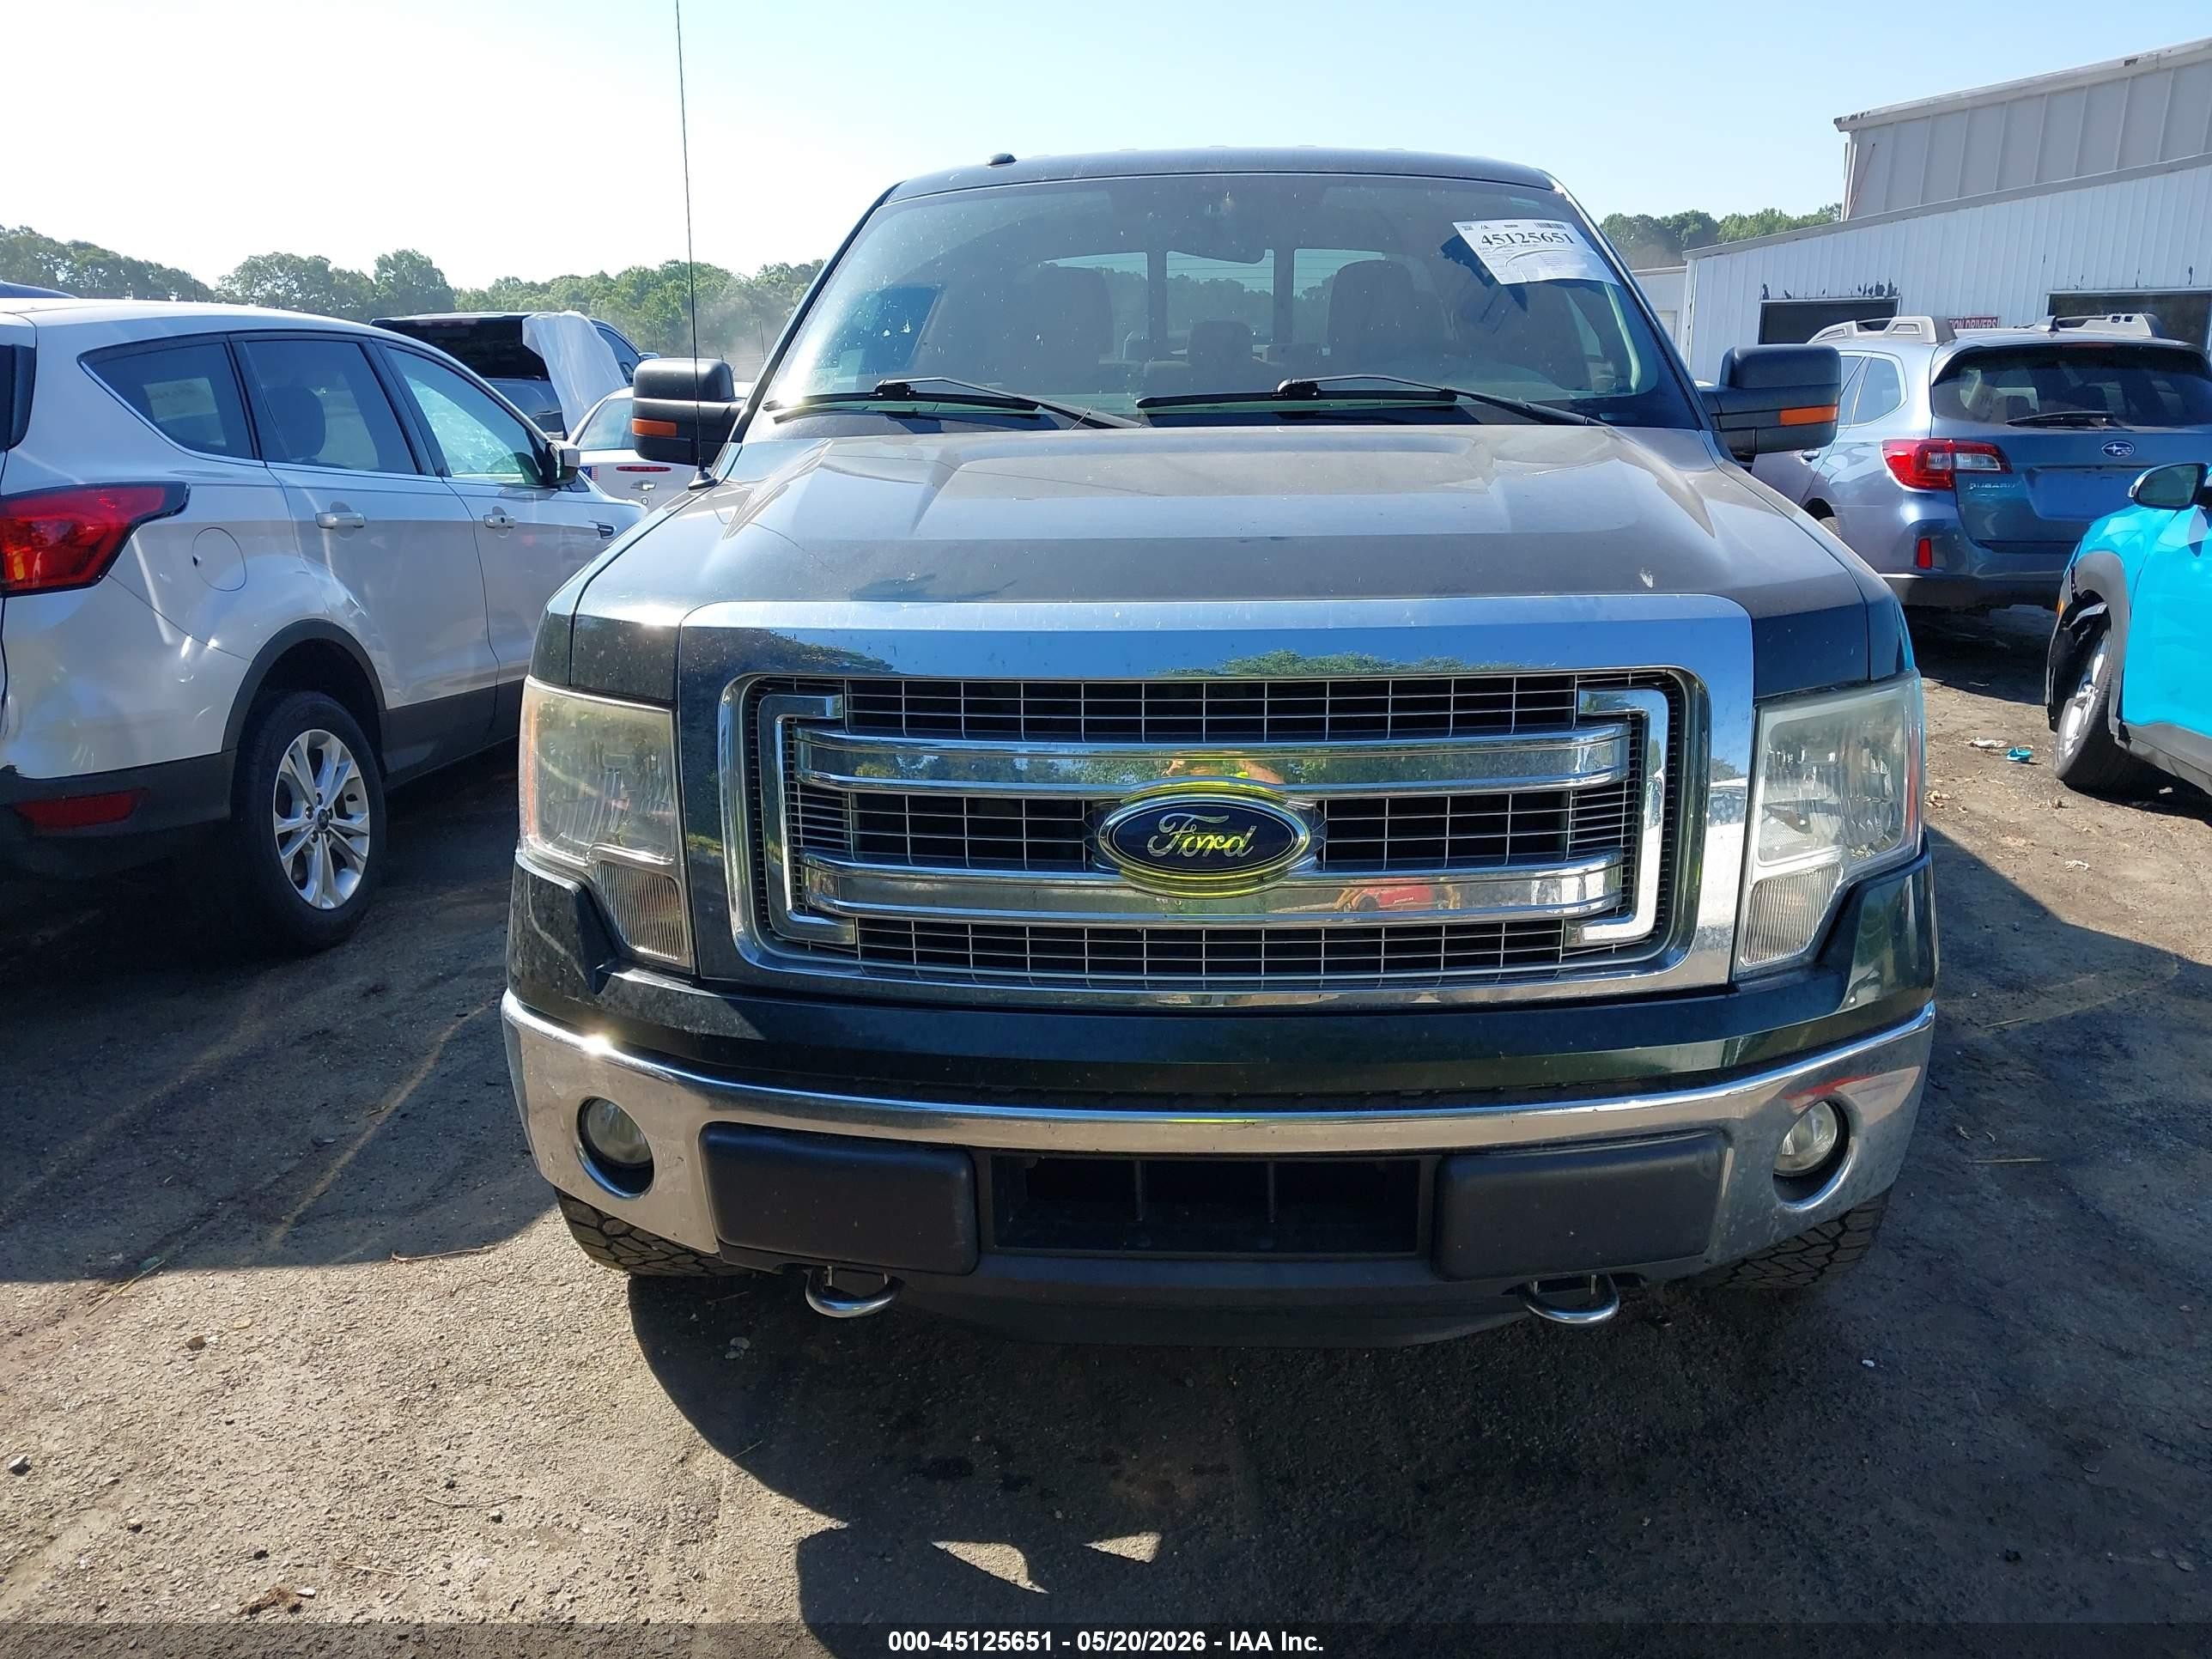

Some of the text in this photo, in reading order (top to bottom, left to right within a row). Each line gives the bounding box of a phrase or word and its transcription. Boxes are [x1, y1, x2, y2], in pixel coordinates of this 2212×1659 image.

[1481, 232, 1575, 246] 45125651
[1965, 319, 1996, 329] DRIVERS
[1147, 812, 1257, 858] Ford
